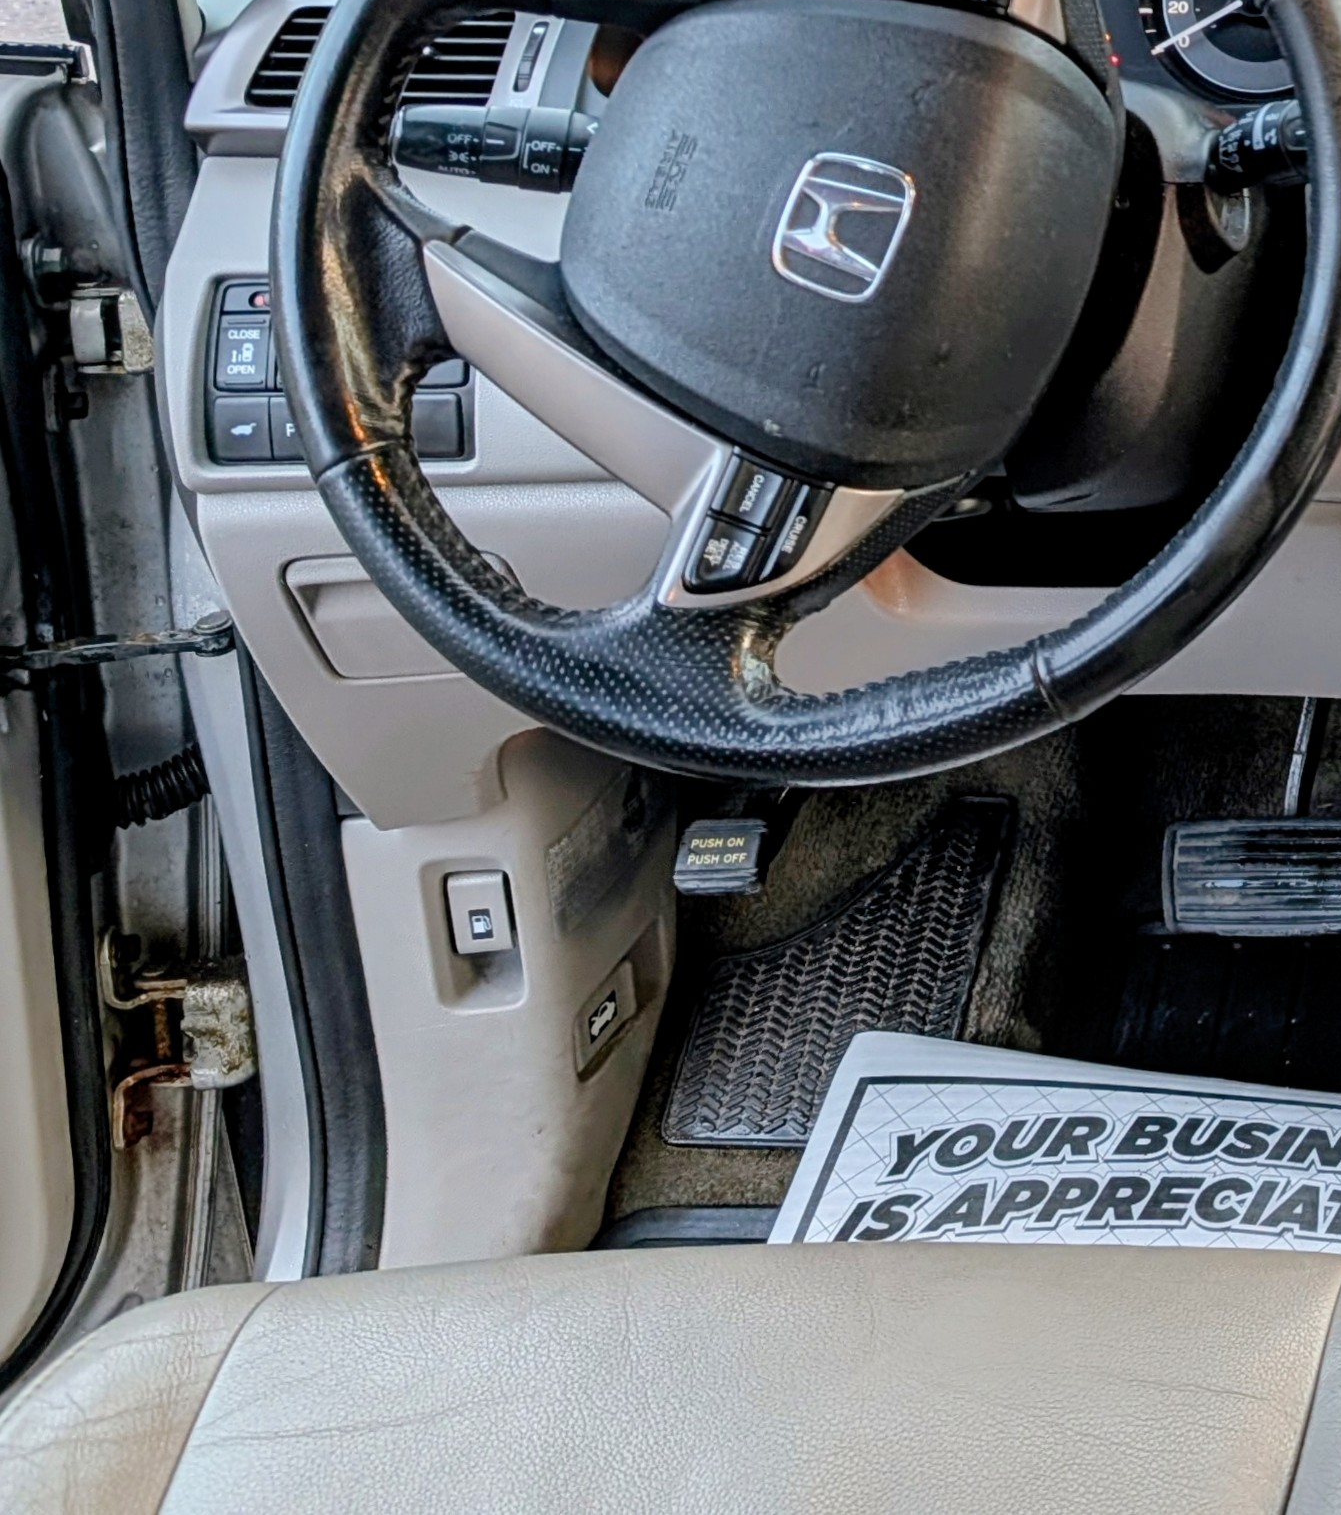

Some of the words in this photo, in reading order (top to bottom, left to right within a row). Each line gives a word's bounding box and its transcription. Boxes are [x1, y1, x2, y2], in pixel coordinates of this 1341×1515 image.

[1168, 1, 1189, 14] 20
[1178, 35, 1190, 48] 0
[448, 133, 471, 144] OFF
[531, 140, 556, 152] OFF
[530, 163, 550, 174] ON
[228, 329, 261, 340] CLOSE
[227, 364, 255, 375] OPEN
[739, 474, 765, 513] CANCEL
[781, 515, 808, 554] CRUISE
[690, 837, 724, 849] PUSH
[727, 836, 745, 848] ON
[687, 853, 720, 866] PUSH
[723, 852, 748, 864] OFF
[885, 1114, 1114, 1184] YOUR
[832, 1190, 930, 1243] IS
